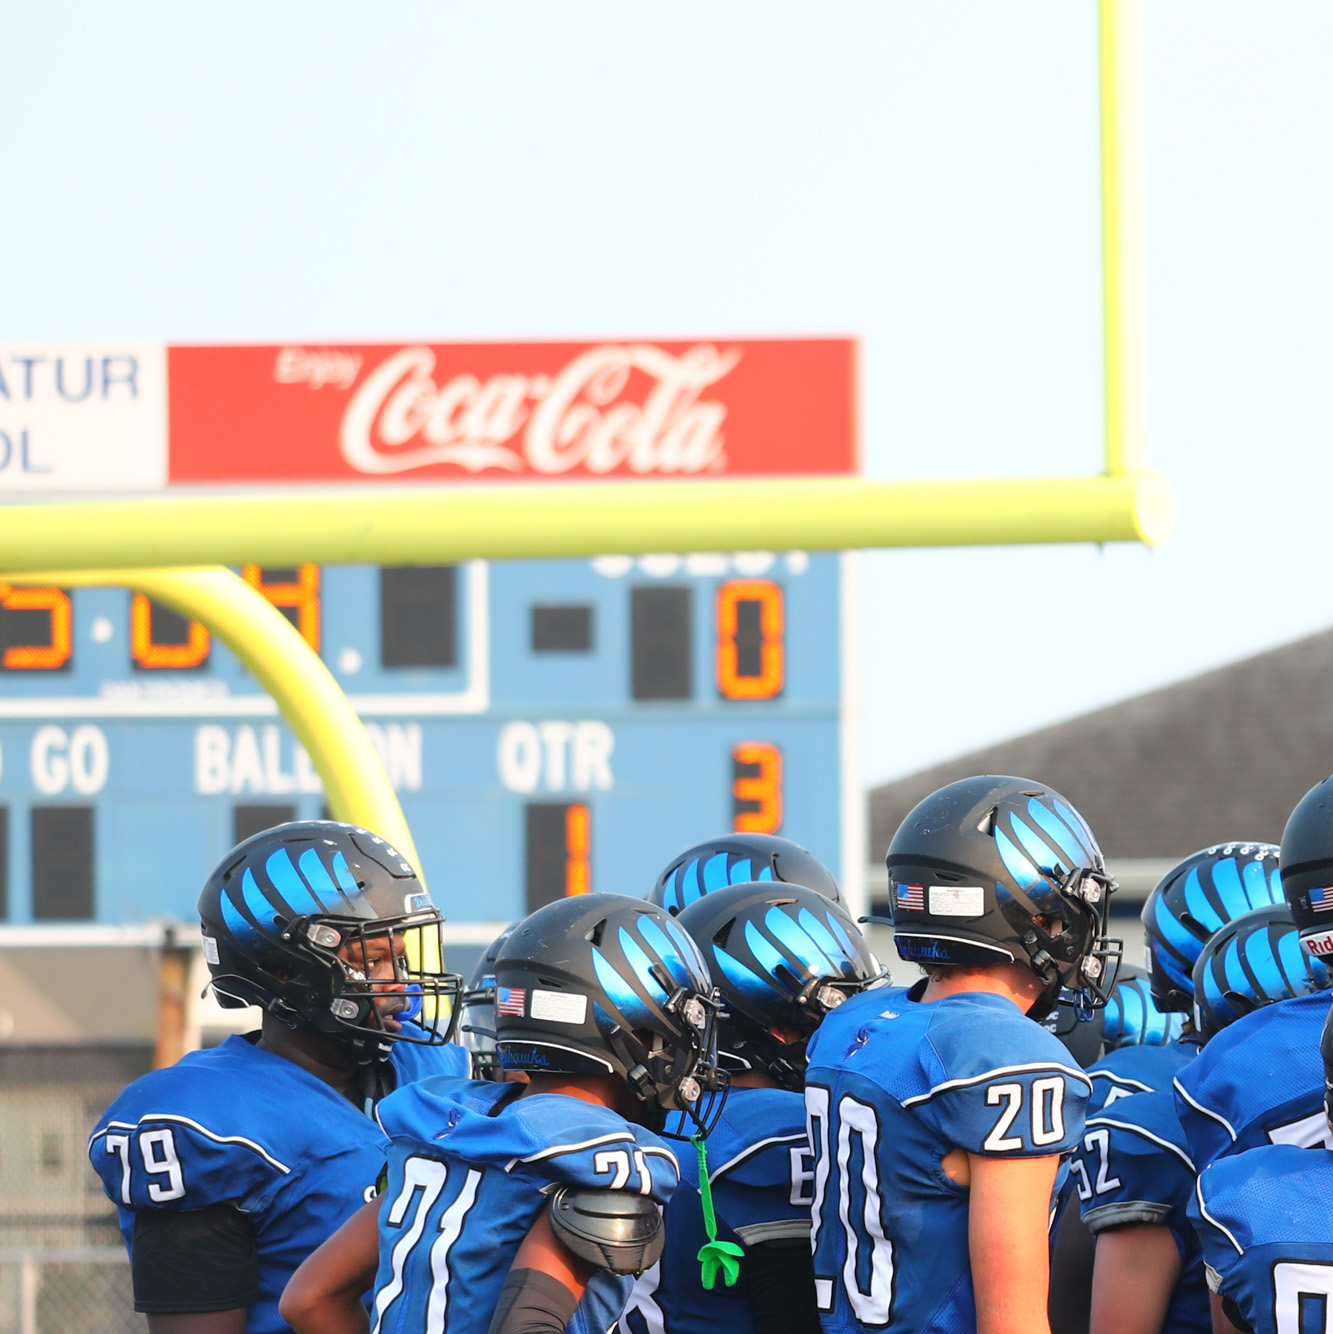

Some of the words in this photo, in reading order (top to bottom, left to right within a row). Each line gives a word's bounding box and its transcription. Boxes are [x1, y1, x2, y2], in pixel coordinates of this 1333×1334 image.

[0, 355, 140, 402] TUR
[272, 347, 364, 390] Enjoy
[338, 344, 745, 477] Coca-Cola
[716, 579, 783, 700] 0
[30, 724, 109, 796] GO
[497, 721, 615, 794] QTR
[732, 741, 783, 834] 3
[984, 1076, 1066, 1152] 20
[105, 1128, 187, 1204] 79
